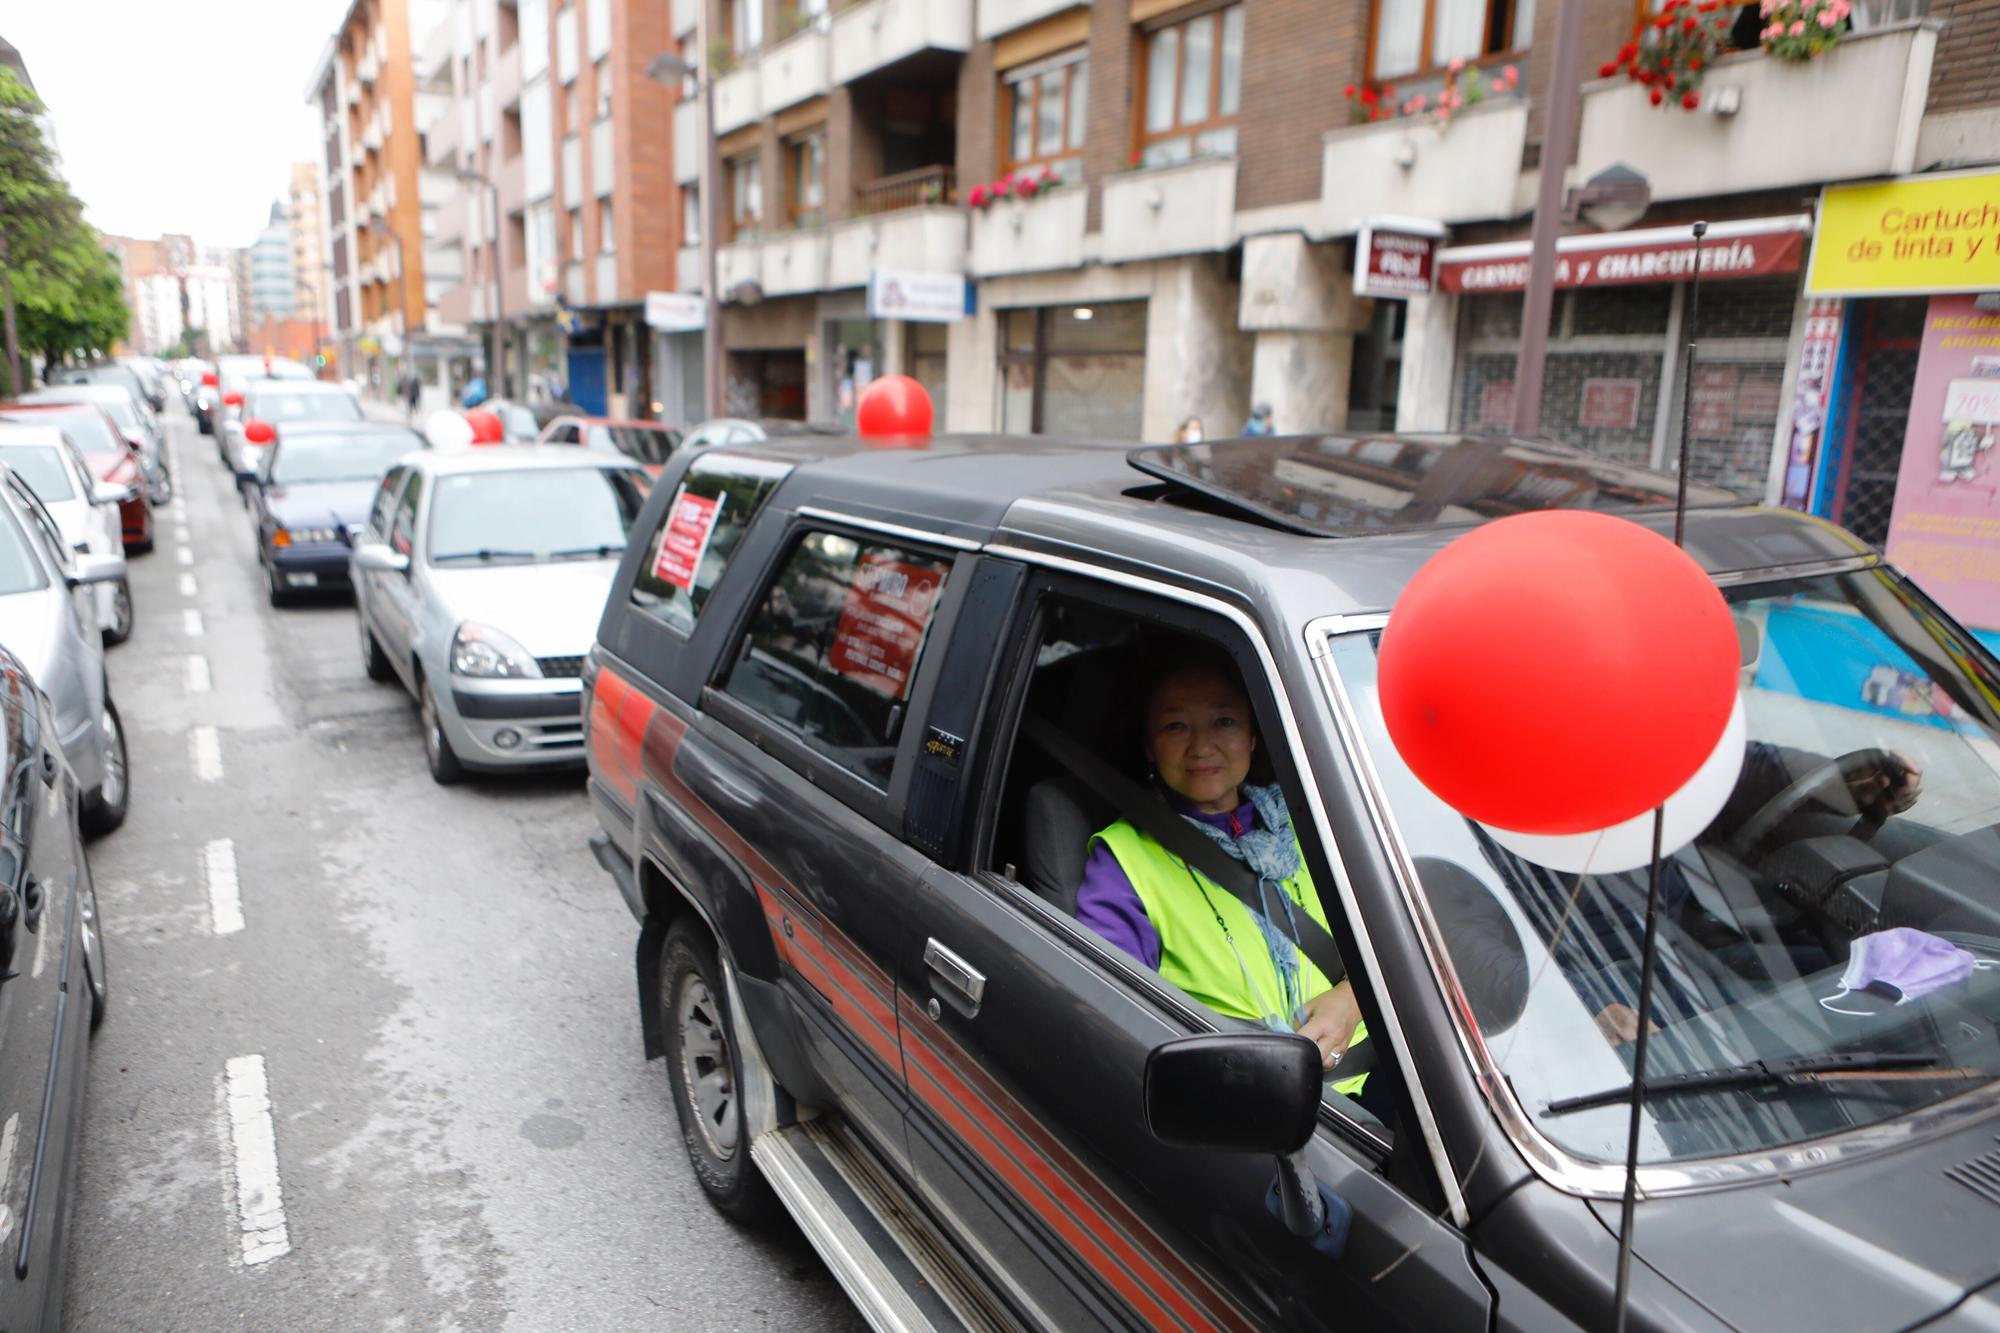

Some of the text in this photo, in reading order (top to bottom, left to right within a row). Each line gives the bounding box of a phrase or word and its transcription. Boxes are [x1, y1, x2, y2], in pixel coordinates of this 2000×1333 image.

[1597, 239, 1755, 279] CHARCUTERÍA
[1847, 235, 1883, 263] de
[1893, 232, 1953, 260] tinta
[1964, 235, 1984, 264] y
